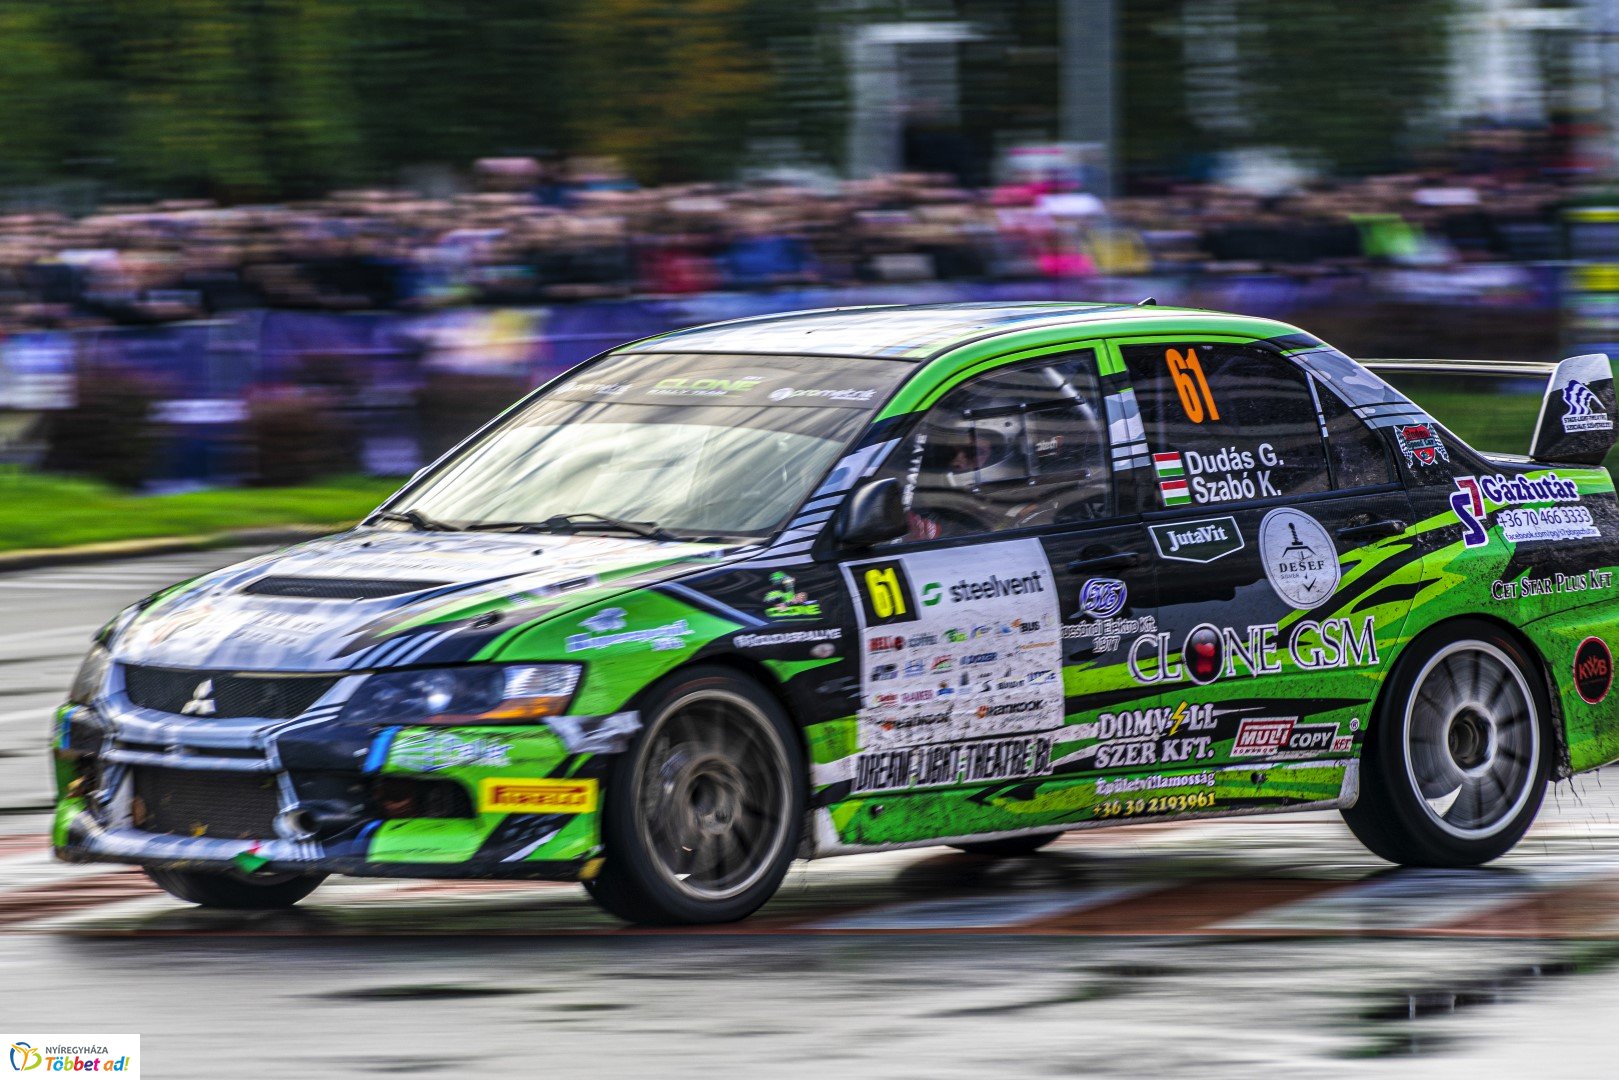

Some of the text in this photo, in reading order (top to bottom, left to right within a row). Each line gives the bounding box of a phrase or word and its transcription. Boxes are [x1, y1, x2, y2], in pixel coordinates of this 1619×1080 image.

[1166, 348, 1220, 424] 61
[1185, 443, 1284, 475] Dudás G.
[1192, 470, 1282, 503] Szabó K.
[1481, 473, 1578, 504] Gázfutár
[1500, 513, 1522, 528] +36
[1522, 511, 1539, 526] 70
[1541, 509, 1562, 524] 466
[1167, 525, 1228, 552] JutaVit
[1279, 560, 1325, 573] DESEF
[864, 567, 906, 618] 61
[951, 571, 1044, 603] steelvent
[1521, 576, 1553, 596] STAR
[1555, 573, 1586, 593] PLUS
[1127, 615, 1379, 685] CLONE GSM
[1240, 724, 1291, 746] MULTI
[1290, 731, 1332, 748] COPY
[1094, 736, 1215, 768] SZER KFT.
[493, 785, 586, 804] PIRELLI
[1093, 801, 1122, 817] +36
[1125, 799, 1146, 815] 30
